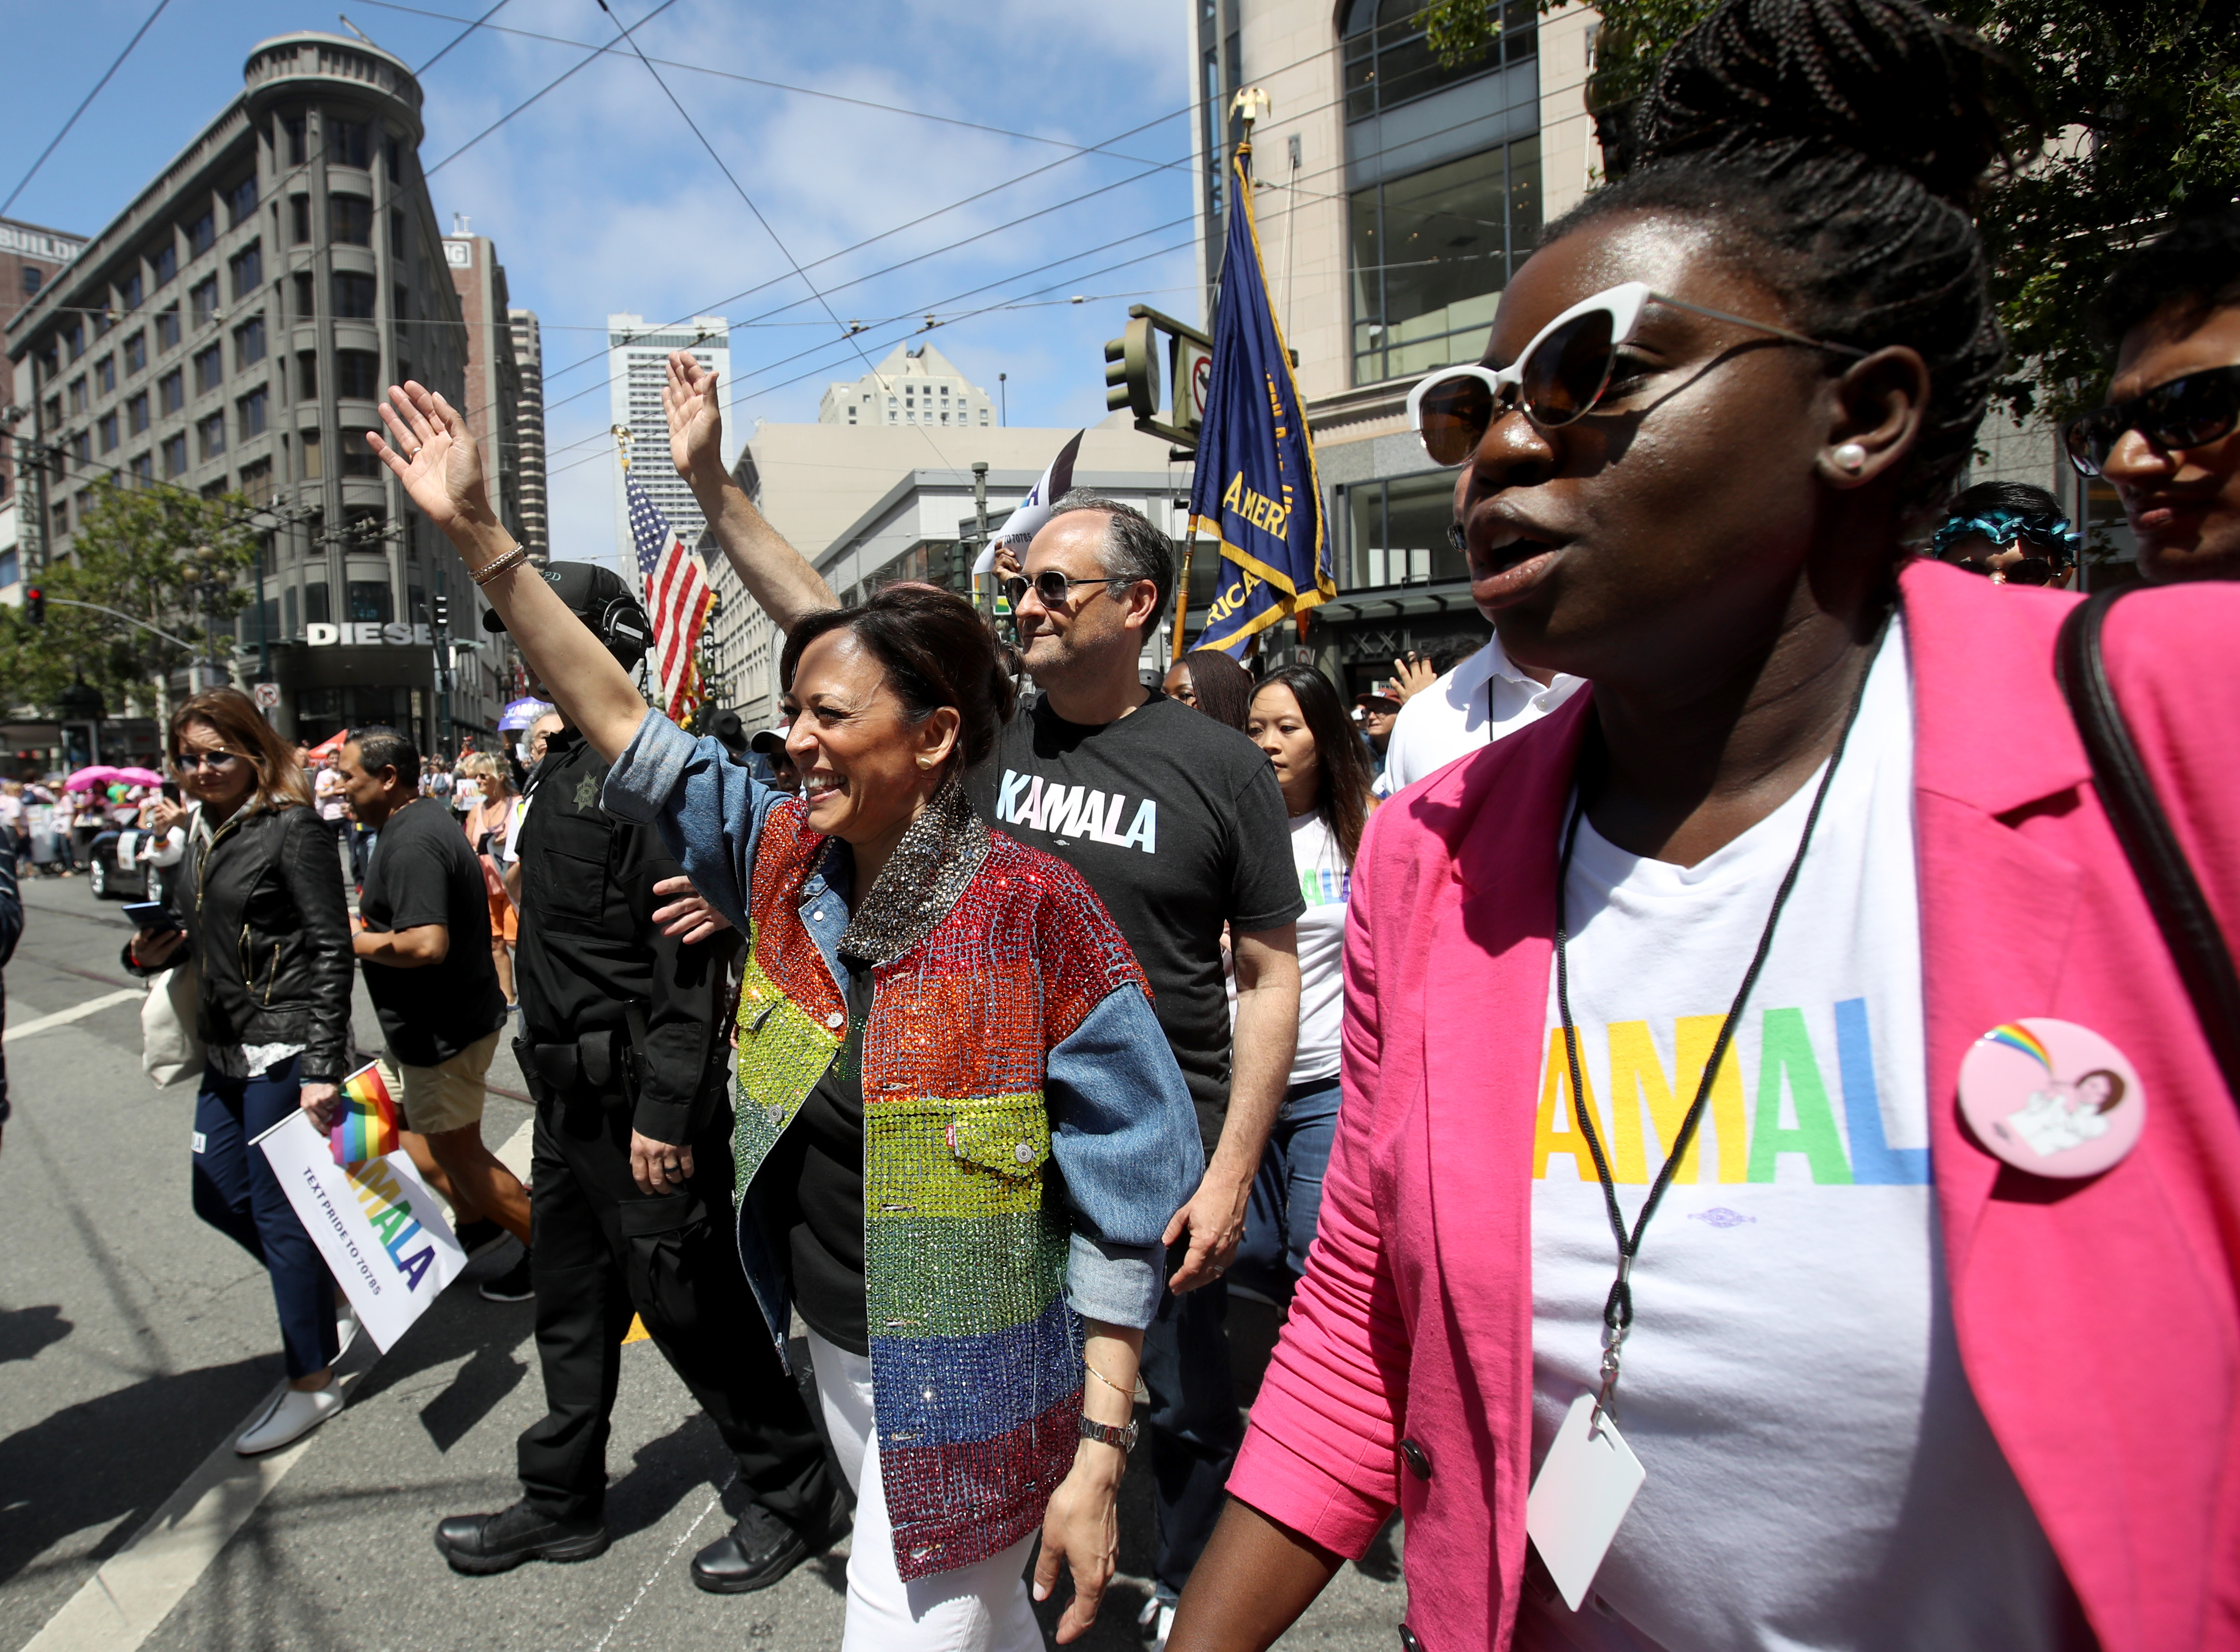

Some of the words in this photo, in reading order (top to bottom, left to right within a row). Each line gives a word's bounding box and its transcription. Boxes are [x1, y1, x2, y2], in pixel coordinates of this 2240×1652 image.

[1012, 532, 1032, 544] 70785
[542, 571, 561, 581] PD
[306, 622, 456, 646] DIESE
[996, 769, 1156, 854] KAMALA
[1533, 997, 1934, 1185] AMAL
[303, 1167, 326, 1200] TEXT
[321, 1200, 349, 1241] PRIDE
[345, 1239, 359, 1258] TO
[356, 1257, 381, 1296] 70785
